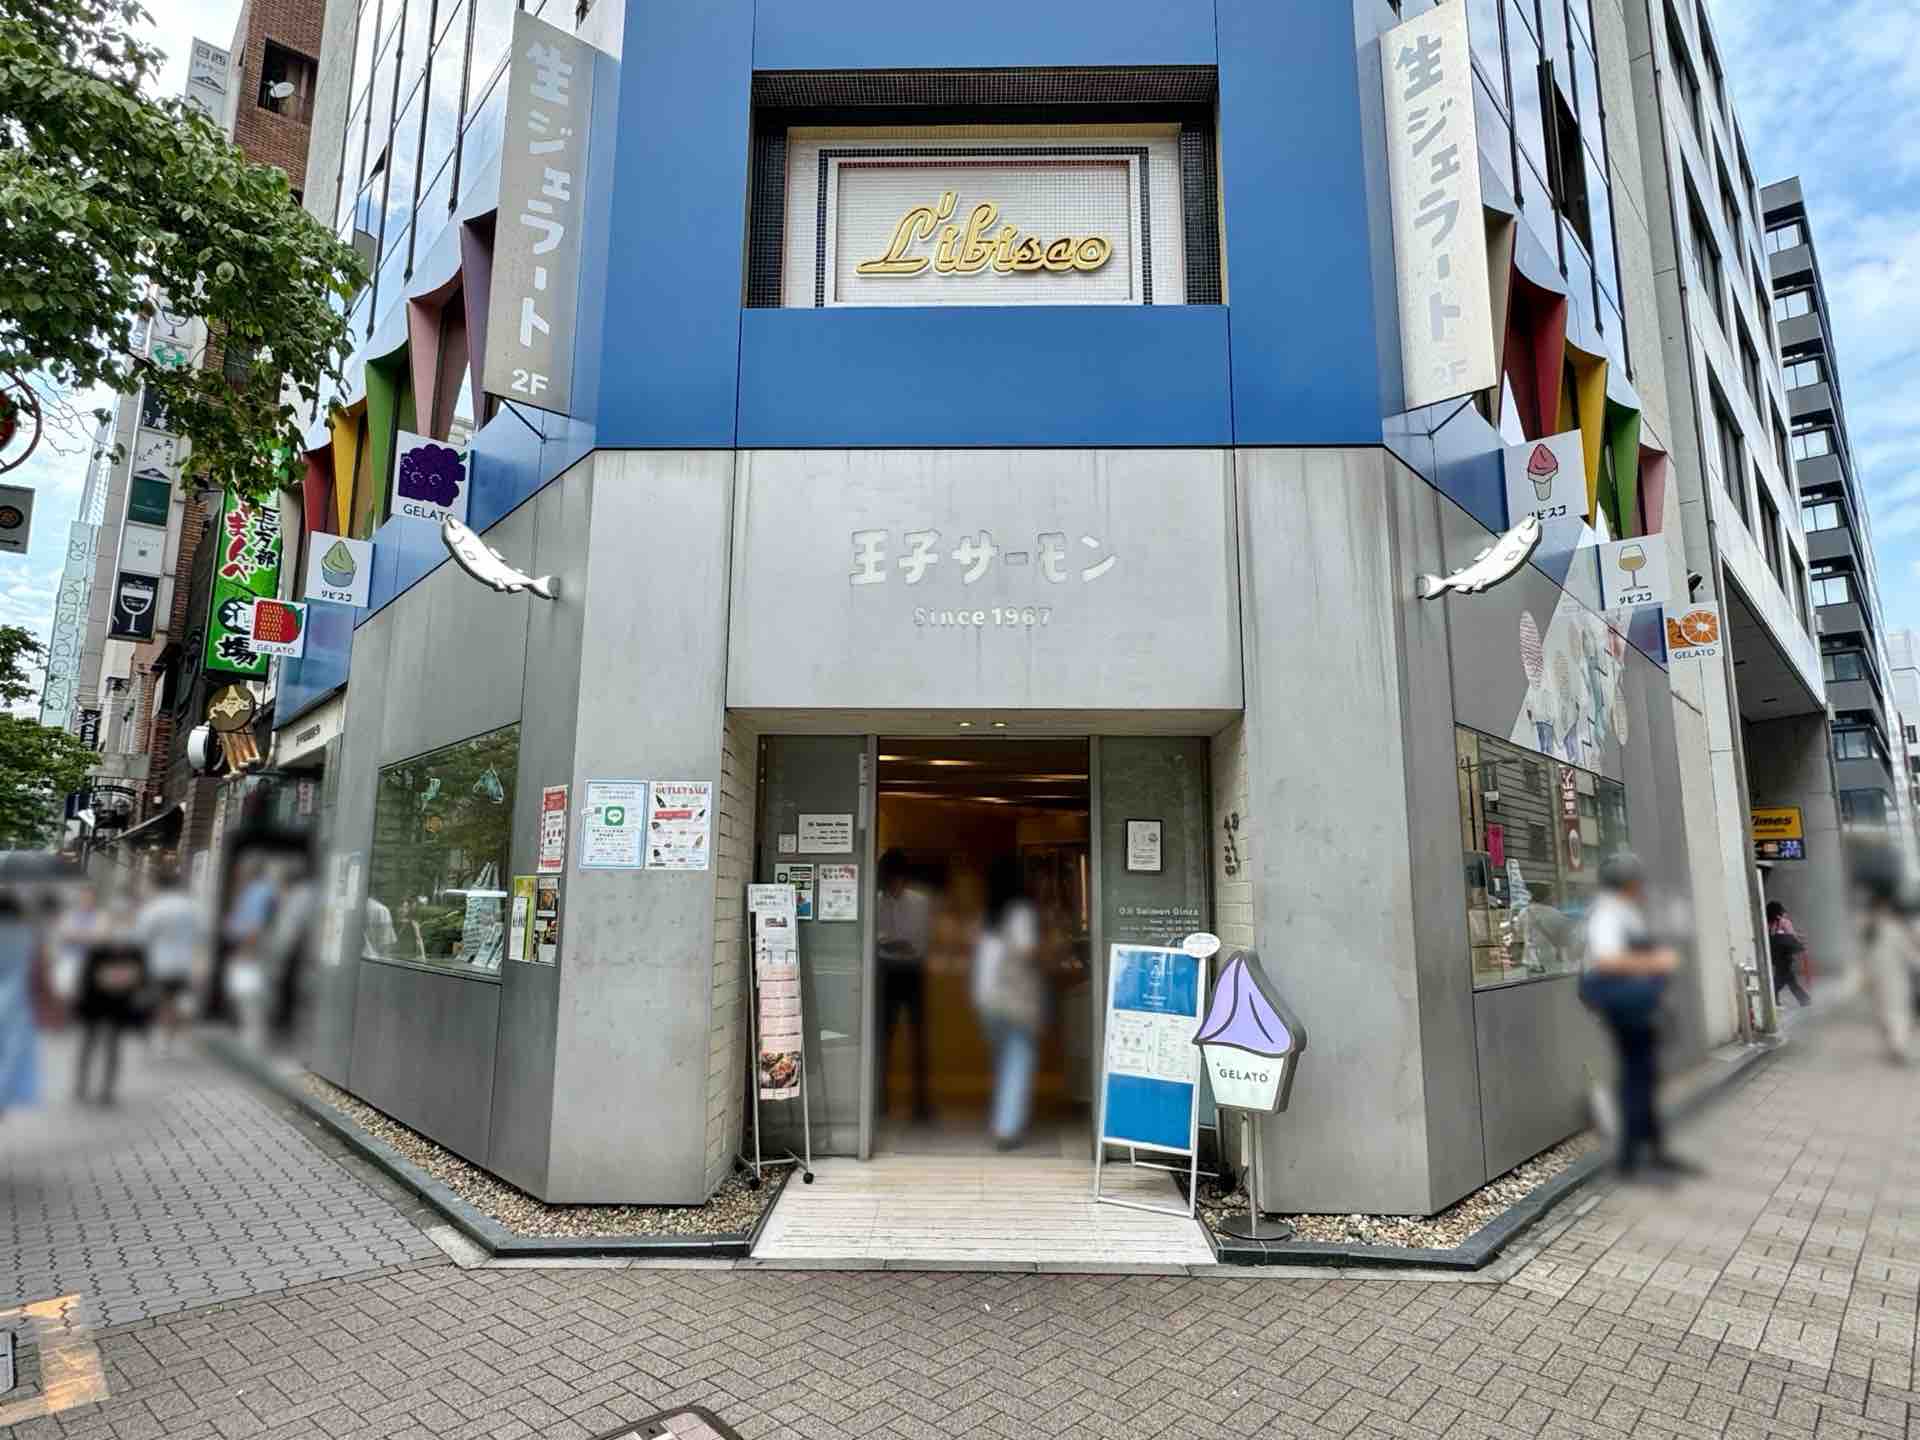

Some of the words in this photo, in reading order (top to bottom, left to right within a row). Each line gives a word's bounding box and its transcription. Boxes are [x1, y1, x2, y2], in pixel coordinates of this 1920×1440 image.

[519, 41, 574, 347] 生ジェラート
[1394, 34, 1462, 342] 生ジェラート
[511, 368, 549, 396] 2F
[850, 529, 1119, 584] 王子サーモン
[321, 590, 353, 602] リビスコ
[1619, 592, 1653, 605] リビスコ
[914, 606, 985, 626] Since
[991, 606, 1052, 626] 1967
[256, 644, 295, 655] GELATO
[1674, 648, 1716, 659] GELATO
[1219, 1068, 1269, 1083] GELATO
